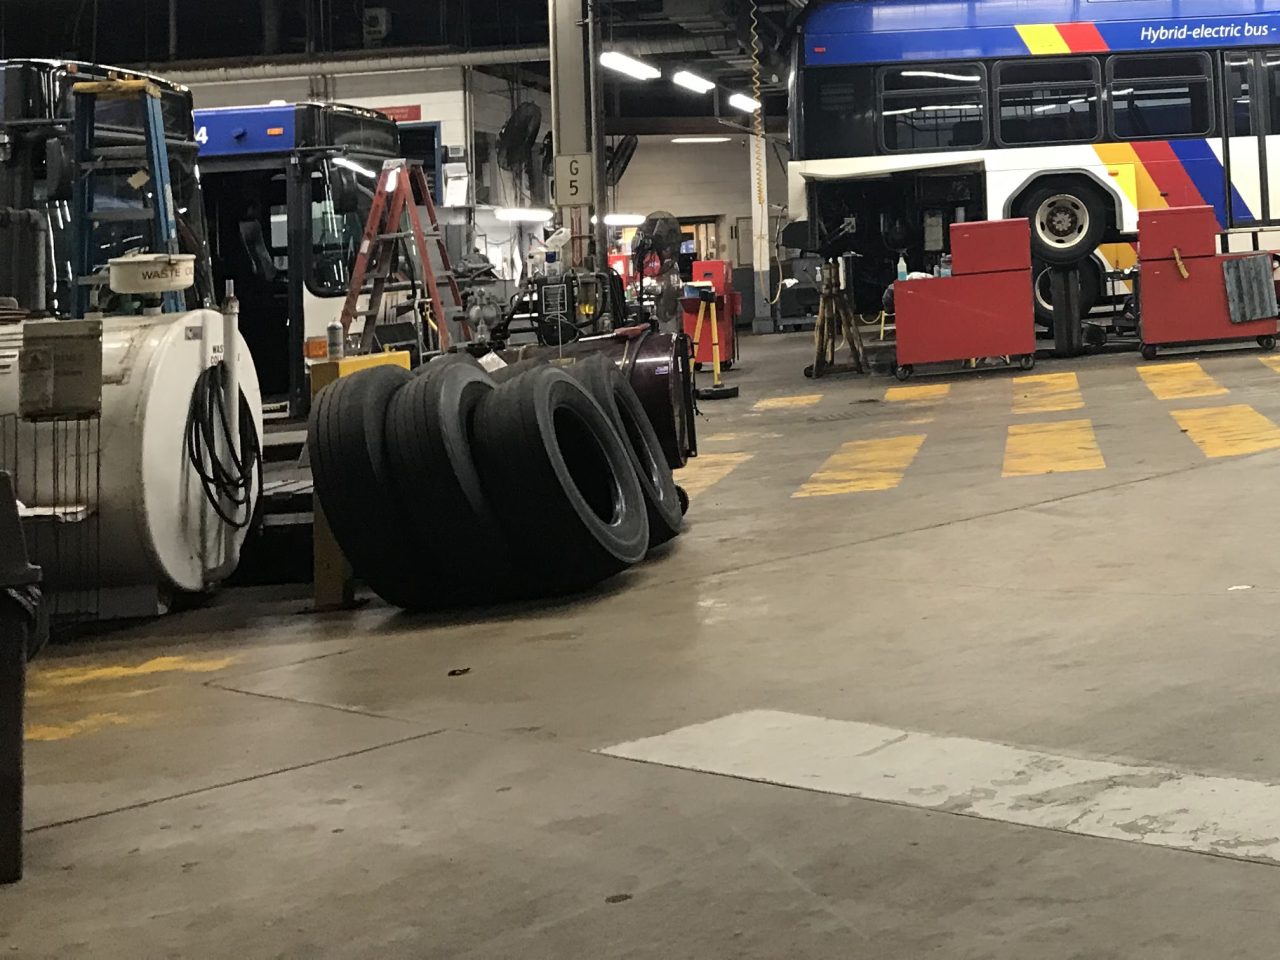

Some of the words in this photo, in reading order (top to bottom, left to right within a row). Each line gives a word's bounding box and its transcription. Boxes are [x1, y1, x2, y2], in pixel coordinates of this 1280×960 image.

[1140, 23, 1241, 44] Hybrid-electric
[1244, 22, 1268, 36] bus
[569, 159, 579, 176] G
[569, 180, 579, 196] 5
[142, 267, 181, 281] WASTE
